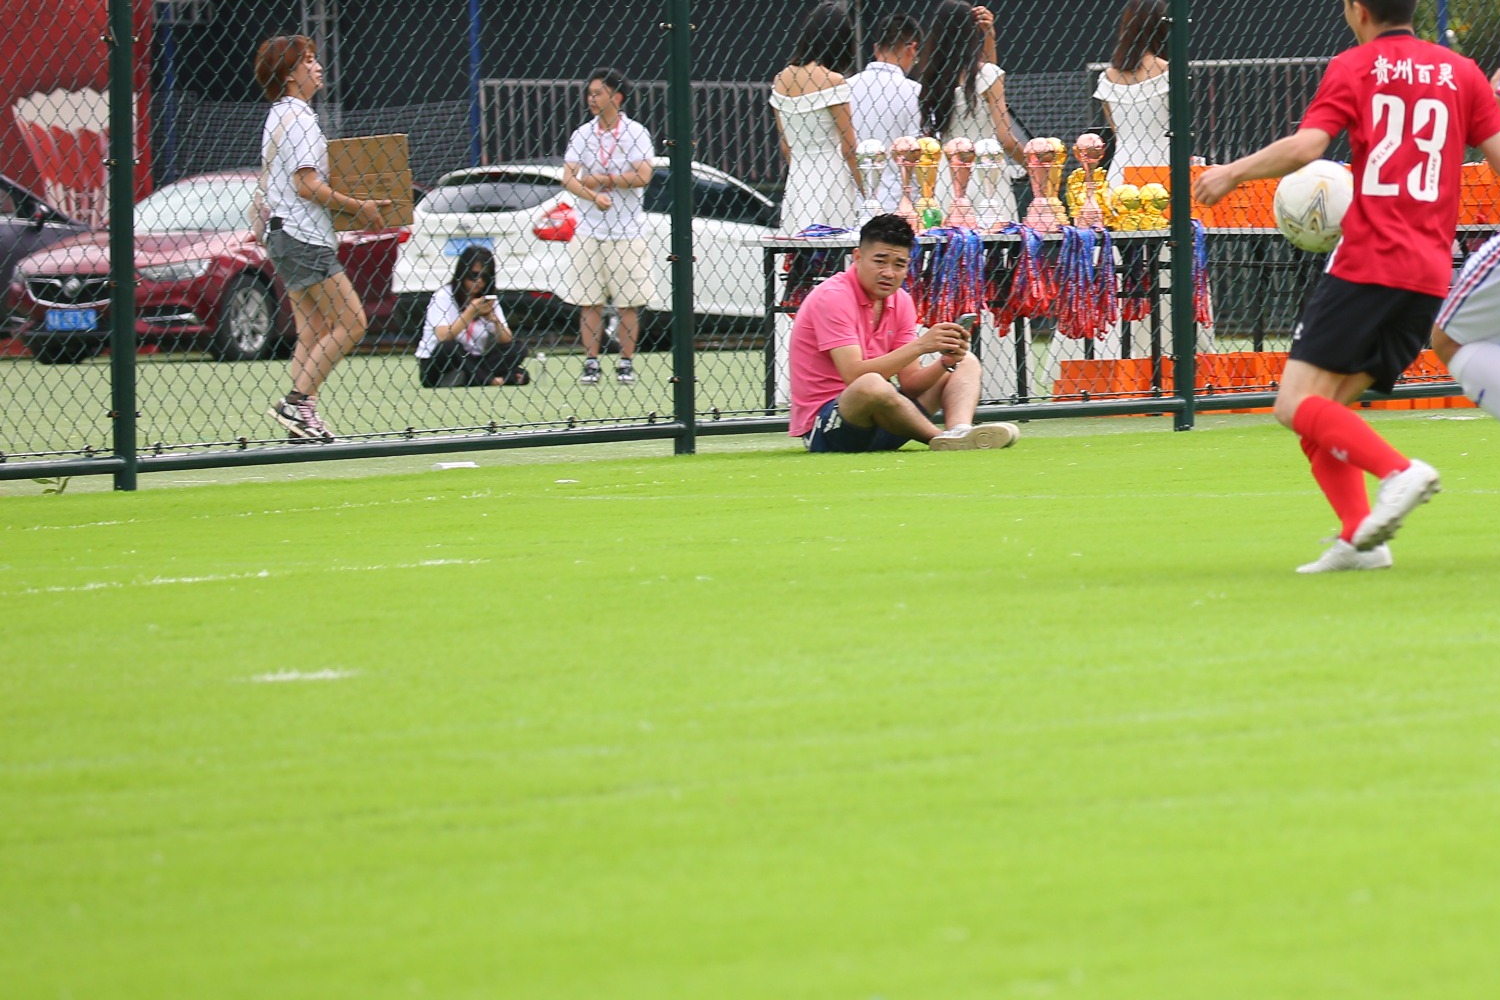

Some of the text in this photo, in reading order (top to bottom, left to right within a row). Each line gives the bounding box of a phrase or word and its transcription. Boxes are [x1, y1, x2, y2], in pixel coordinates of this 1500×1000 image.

[1370, 54, 1458, 91] 贵州百灵
[1361, 93, 1449, 203] 23
